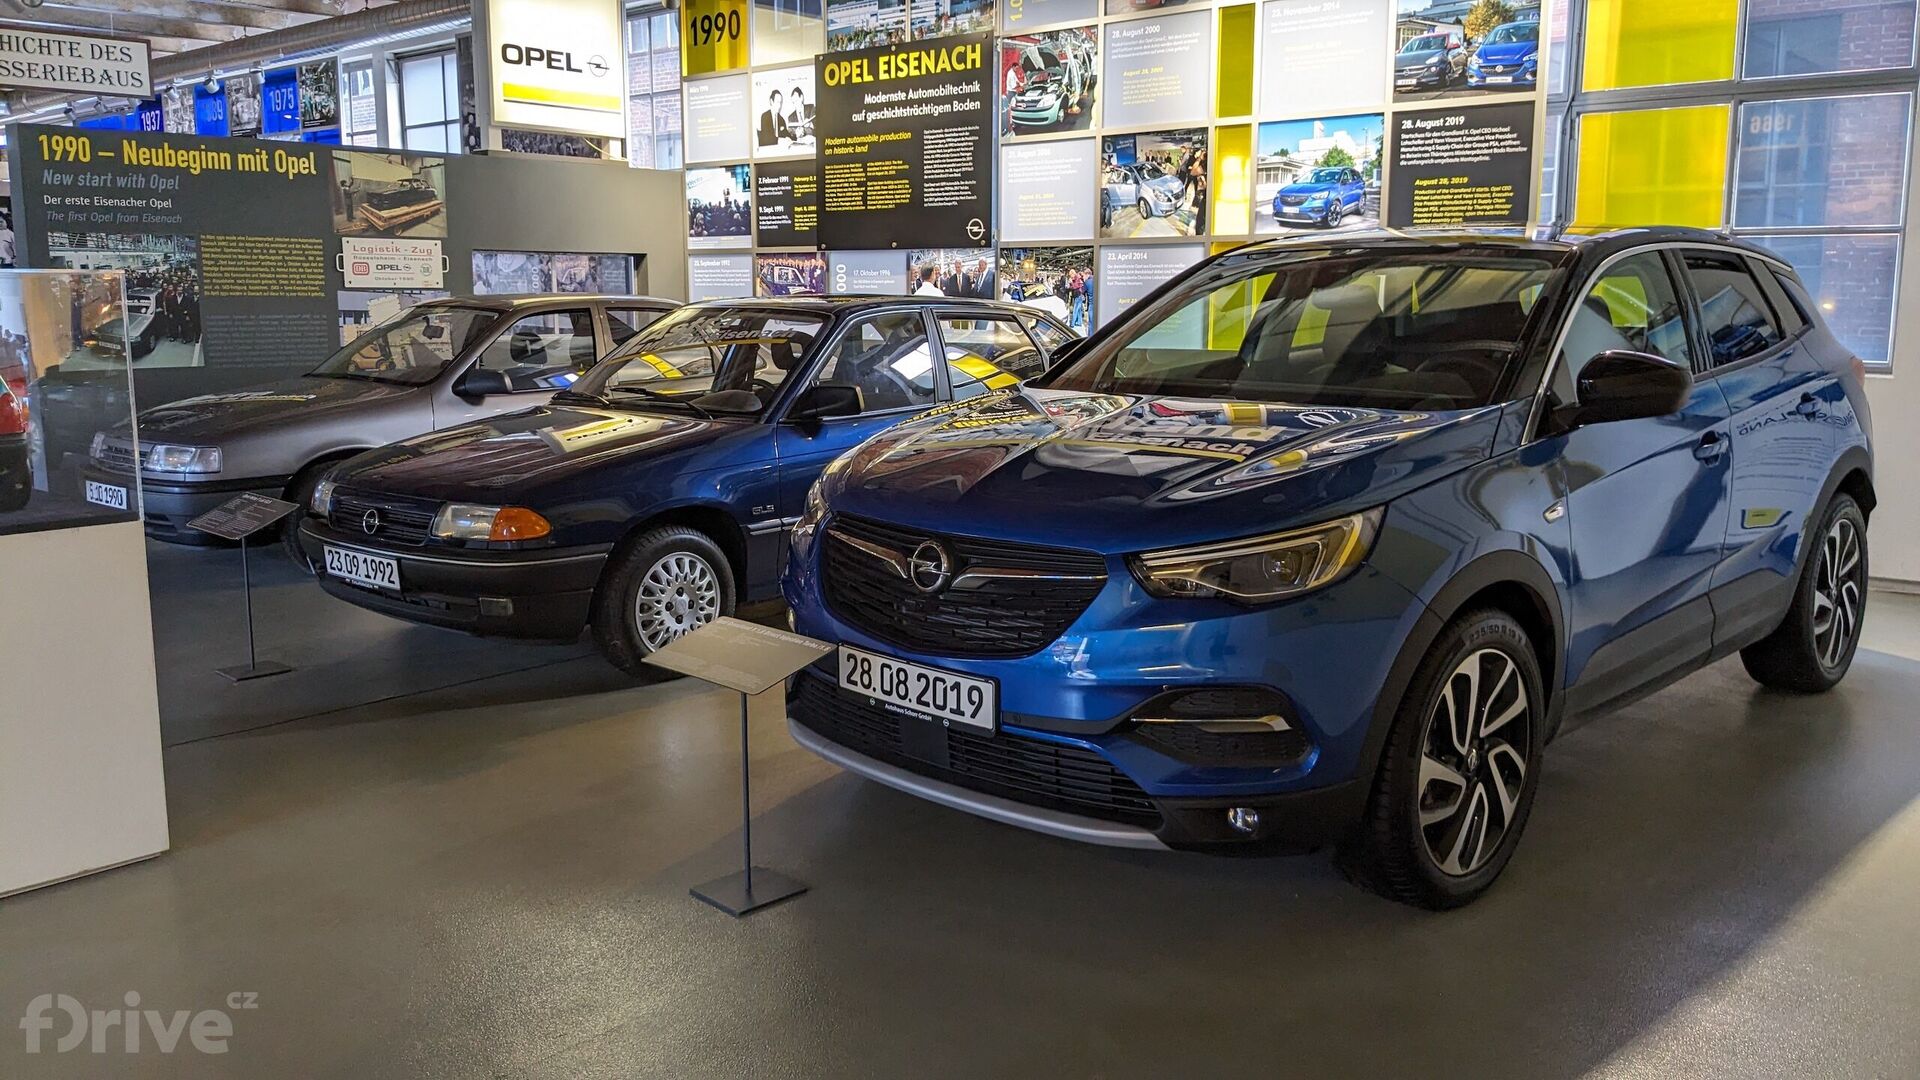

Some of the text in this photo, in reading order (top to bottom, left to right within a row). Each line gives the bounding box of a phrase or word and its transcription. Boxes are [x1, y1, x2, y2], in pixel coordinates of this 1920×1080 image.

[690, 9, 741, 47] 1990
[1112, 25, 1160, 39] 28. August 2000
[90, 43, 132, 63] DES
[501, 43, 582, 73] OPEL
[824, 44, 981, 87] OPEL EISENACH
[269, 87, 294, 112] 1975
[864, 82, 980, 105] Modernste Automobiltechnik
[141, 110, 160, 131] 1937
[852, 100, 980, 123] auf geschichtsträchtigem Boden
[1401, 116, 1465, 129] 28. August 2019
[825, 132, 911, 146] Modern automobile production
[39, 134, 91, 163] 1990
[123, 140, 231, 175] Neubeginn
[238, 148, 269, 172] mit
[275, 150, 317, 179] Opel
[834, 147, 854, 155] historic
[855, 144, 869, 153] land
[43, 169, 180, 192] New start with Opel
[1415, 178, 1438, 186] August
[1450, 176, 1468, 184] 2019
[44, 195, 172, 209] Der erste Eisenacher Opel
[47, 210, 182, 225] The first Opel from Eisenach
[353, 245, 400, 254] Logistik
[411, 246, 433, 255] Zug
[1107, 251, 1148, 261] 23. April 2014
[860, 269, 878, 277] Oktober
[328, 549, 396, 585] 23.09.1992
[846, 653, 983, 719] 28.08.2019
[885, 703, 904, 713] Autohaus
[918, 712, 932, 722] GmbH
